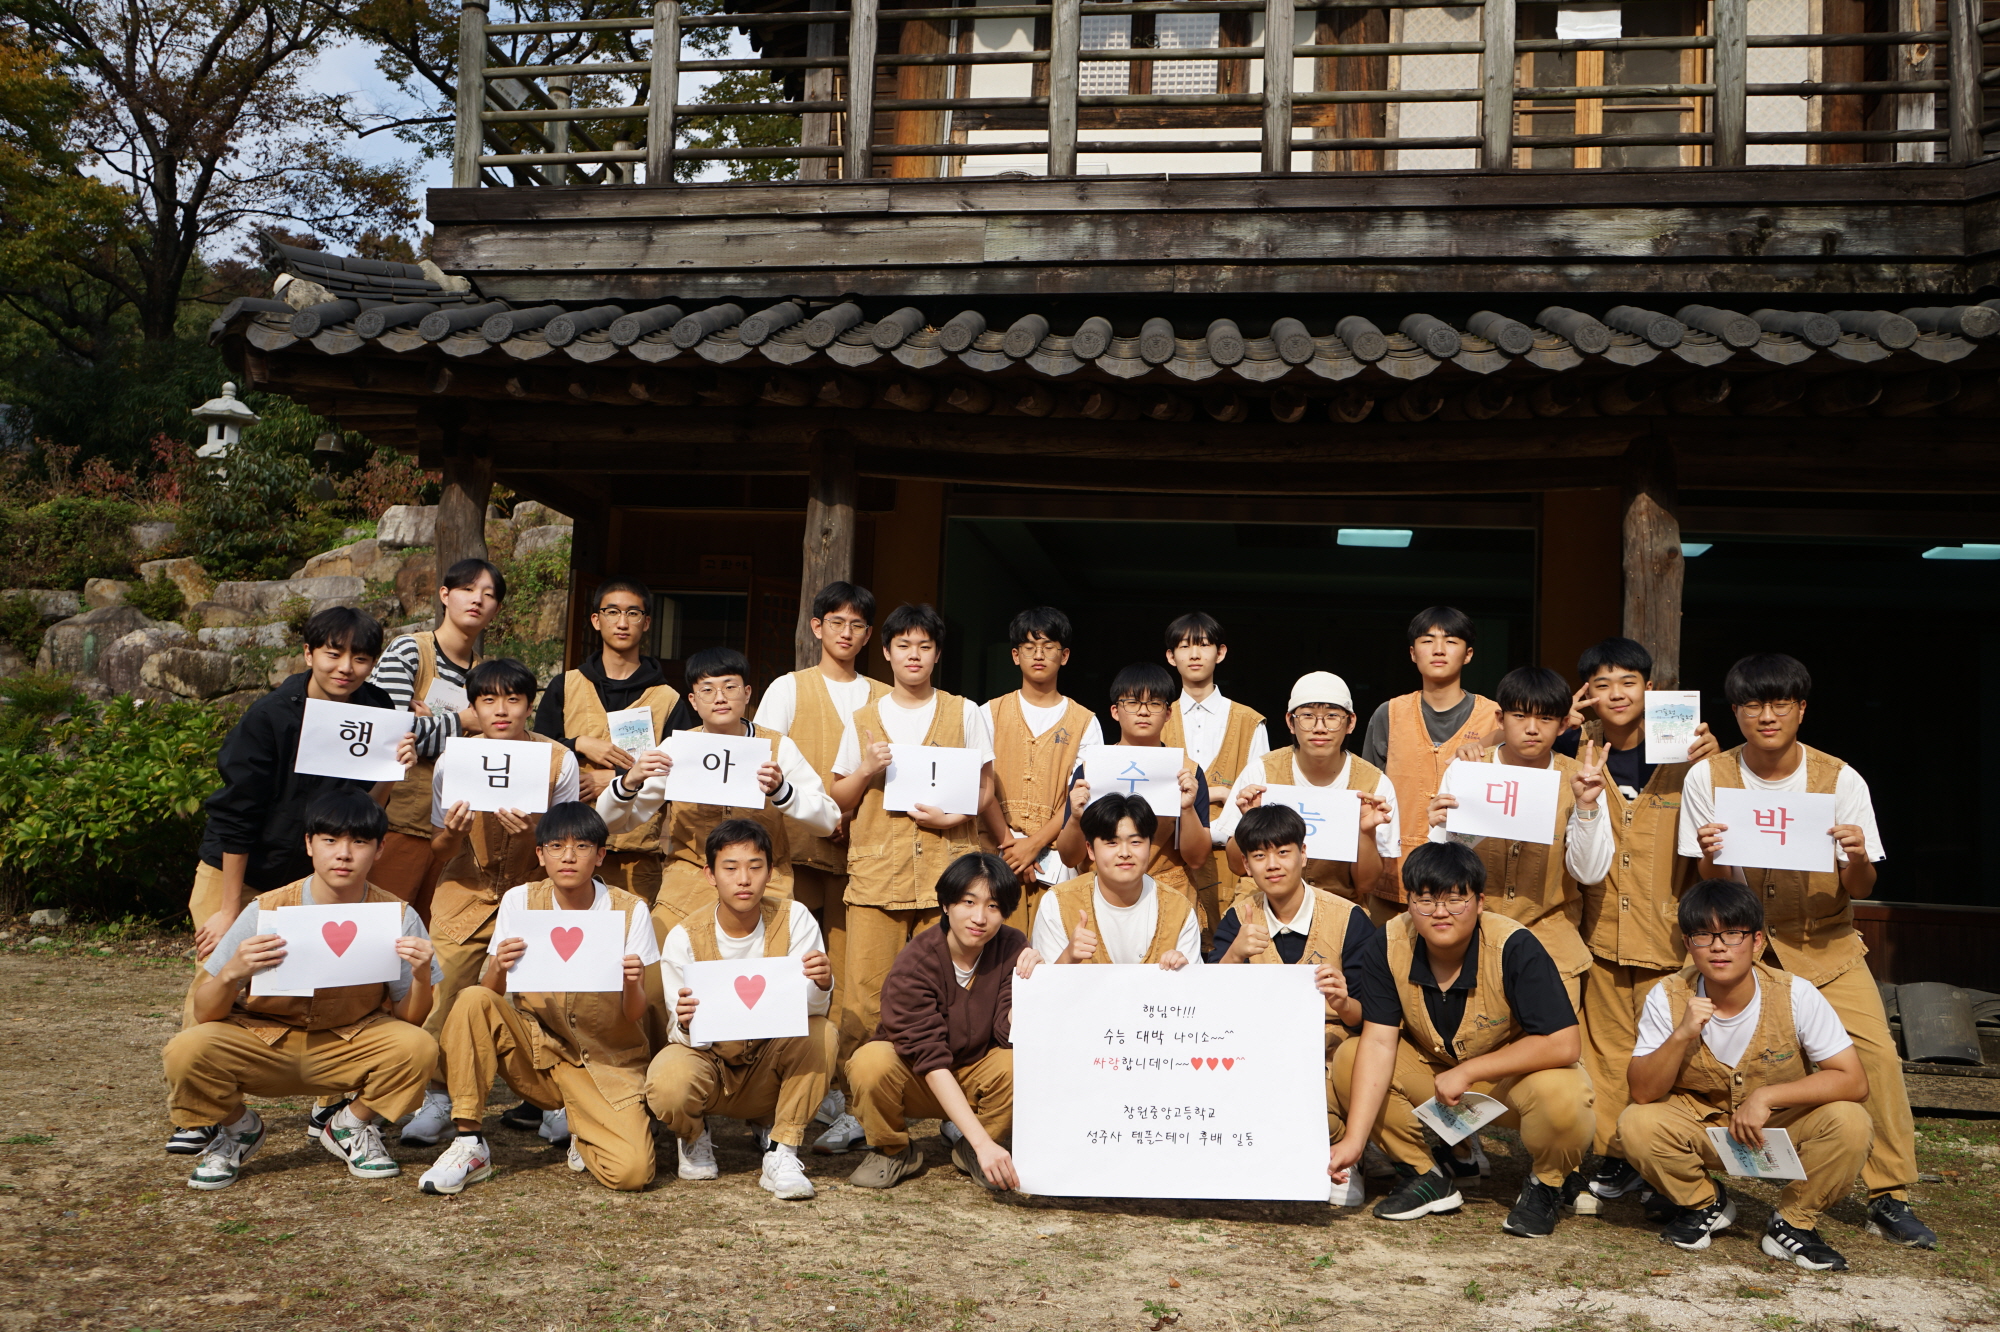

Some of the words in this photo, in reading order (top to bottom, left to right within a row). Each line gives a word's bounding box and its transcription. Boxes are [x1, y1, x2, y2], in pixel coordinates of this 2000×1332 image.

[339, 720, 374, 758] 행
[481, 753, 511, 789] 님
[702, 749, 736, 784] 아
[931, 761, 937, 787] !
[1116, 761, 1150, 793] 수
[1486, 780, 1519, 817] 대
[1298, 802, 1326, 836] 능
[1753, 806, 1795, 846] 박
[1142, 1004, 1196, 1019] 행님아!!!
[1103, 1028, 1125, 1045] 수능
[1136, 1030, 1165, 1046] 대박
[1123, 1104, 1216, 1121] 창원중앙고등학교
[1086, 1129, 1123, 1145] 성주사
[1131, 1130, 1190, 1145] 템플스테이
[1198, 1130, 1223, 1146] 후배
[1232, 1132, 1253, 1147] 일동
